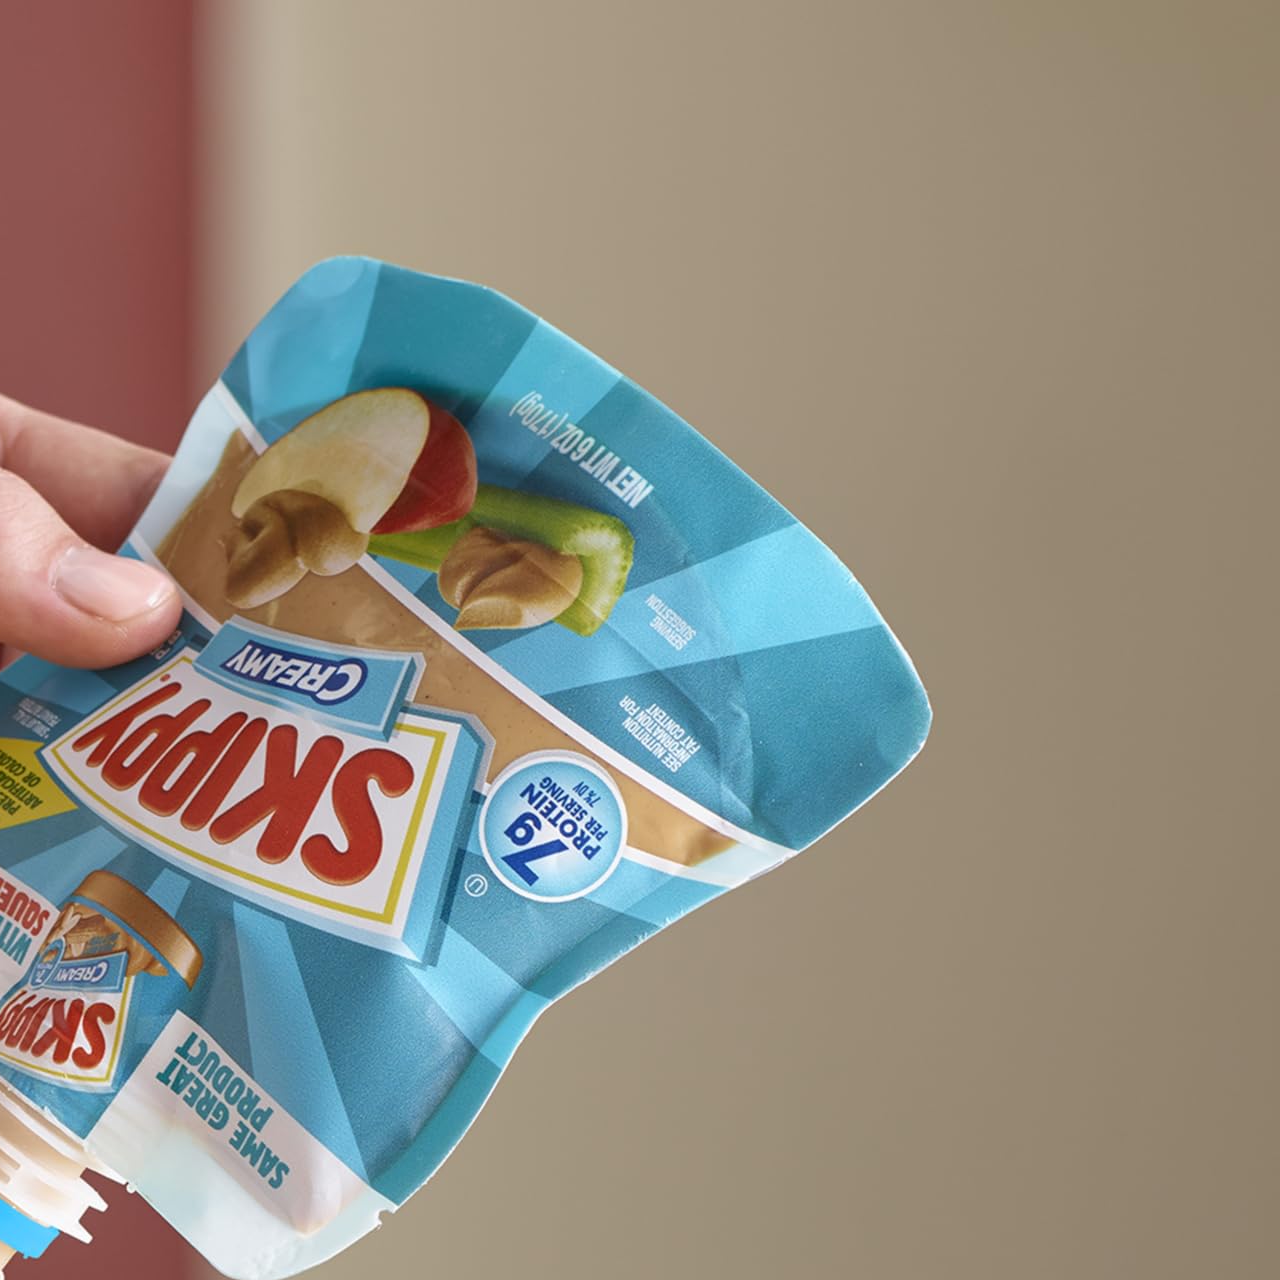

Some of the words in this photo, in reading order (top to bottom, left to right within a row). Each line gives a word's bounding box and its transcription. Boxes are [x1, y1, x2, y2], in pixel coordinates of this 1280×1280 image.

[508, 390, 569, 439] (170g)
[550, 423, 585, 454] OZ
[570, 436, 596, 462] 6
[579, 445, 621, 484] WT
[604, 465, 655, 509] NET
[644, 593, 697, 642] SUGGESTION
[649, 615, 688, 650] SERVING
[227, 644, 364, 702] CREAMY
[619, 695, 640, 715] FOR
[646, 703, 686, 739] CONTENT
[622, 716, 669, 760] NUTRITION
[636, 710, 691, 765] INFORMATION
[680, 735, 701, 755] FAT
[22, 771, 42, 788] OR
[661, 754, 682, 773] SEE
[539, 776, 588, 822] SERVING
[572, 781, 589, 797] DV
[583, 791, 601, 808] 7%
[520, 782, 602, 861] PROTEIN
[584, 816, 609, 842] PER
[500, 811, 569, 887] 7g
[53, 961, 107, 983] CREAMY
[155, 1058, 230, 1130] GREAT
[174, 1031, 274, 1132] PRODUCT
[228, 1120, 290, 1189] SAME
